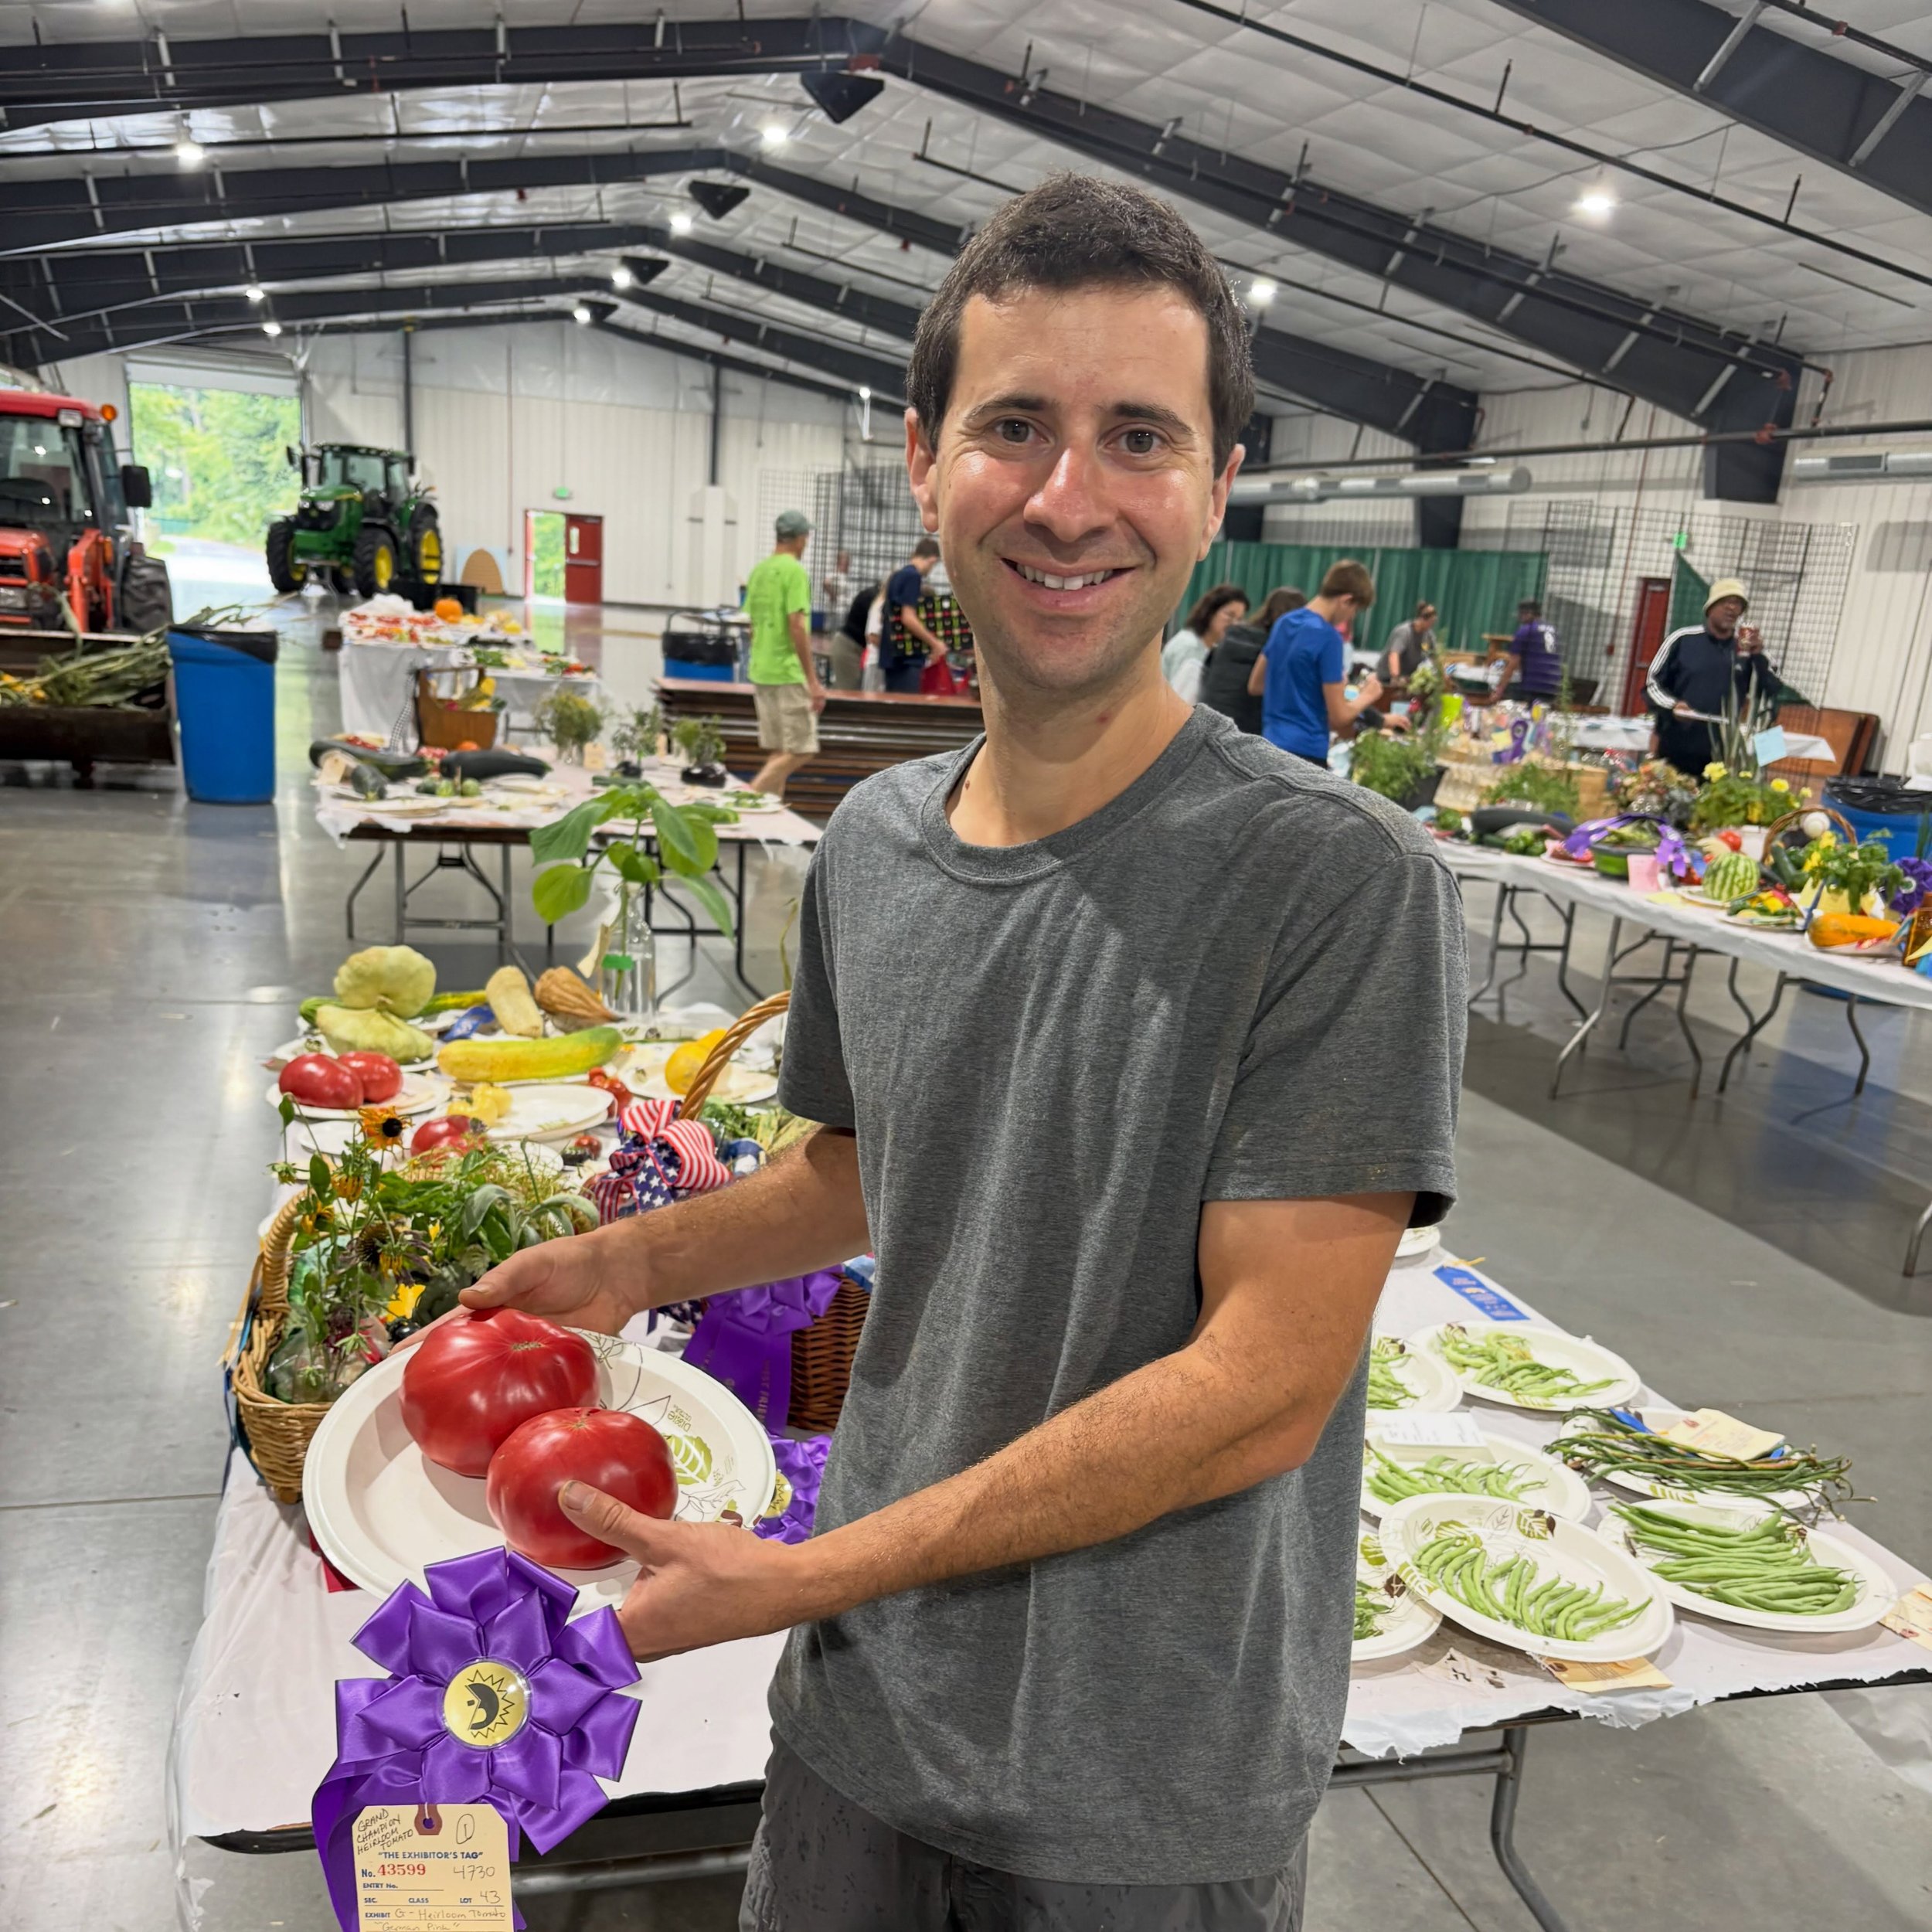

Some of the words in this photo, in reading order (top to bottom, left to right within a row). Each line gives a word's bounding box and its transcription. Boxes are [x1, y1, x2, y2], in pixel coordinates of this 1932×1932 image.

[357, 1814, 401, 1843] CHAMPION
[358, 1808, 389, 1832] GRAND
[357, 1827, 399, 1855] HEIRLOOM
[379, 1828, 414, 1850] TOMATO
[361, 1869, 376, 1878] No.
[377, 1863, 426, 1876] 43599
[453, 1865, 495, 1881] 4730
[480, 1890, 501, 1904] 43
[418, 1908, 467, 1920] Heirloom
[468, 1907, 507, 1919] Tomato
